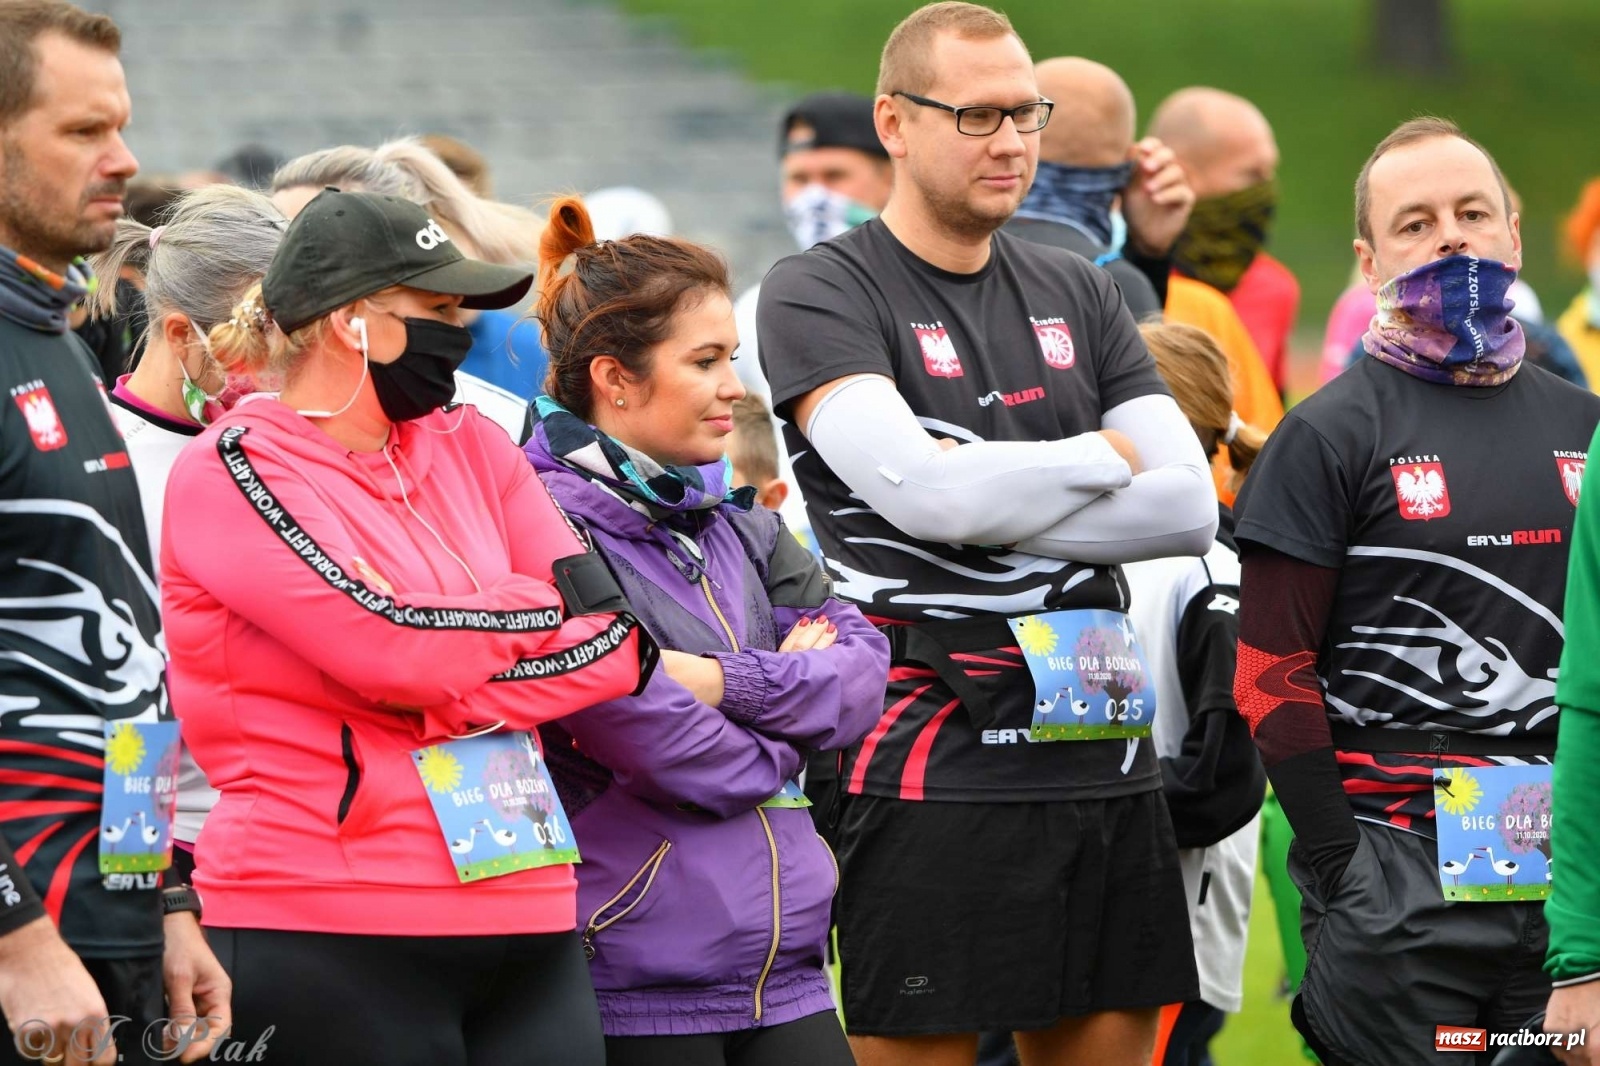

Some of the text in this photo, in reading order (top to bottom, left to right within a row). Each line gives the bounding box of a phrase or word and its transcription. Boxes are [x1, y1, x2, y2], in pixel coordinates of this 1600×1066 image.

[1390, 454, 1440, 466] POLSKA
[1553, 450, 1588, 460] RACIBÓR
[1047, 655, 1074, 671] BIEG
[1079, 655, 1100, 671] DLA
[1105, 698, 1143, 721] 025
[124, 776, 151, 795] BIEG
[452, 787, 484, 807] BIEG
[489, 781, 513, 800] DLA
[533, 815, 566, 845] 036
[1461, 815, 1496, 831] BIEG
[1505, 814, 1533, 829] DLA
[1516, 831, 1547, 839] 11.10.2020
